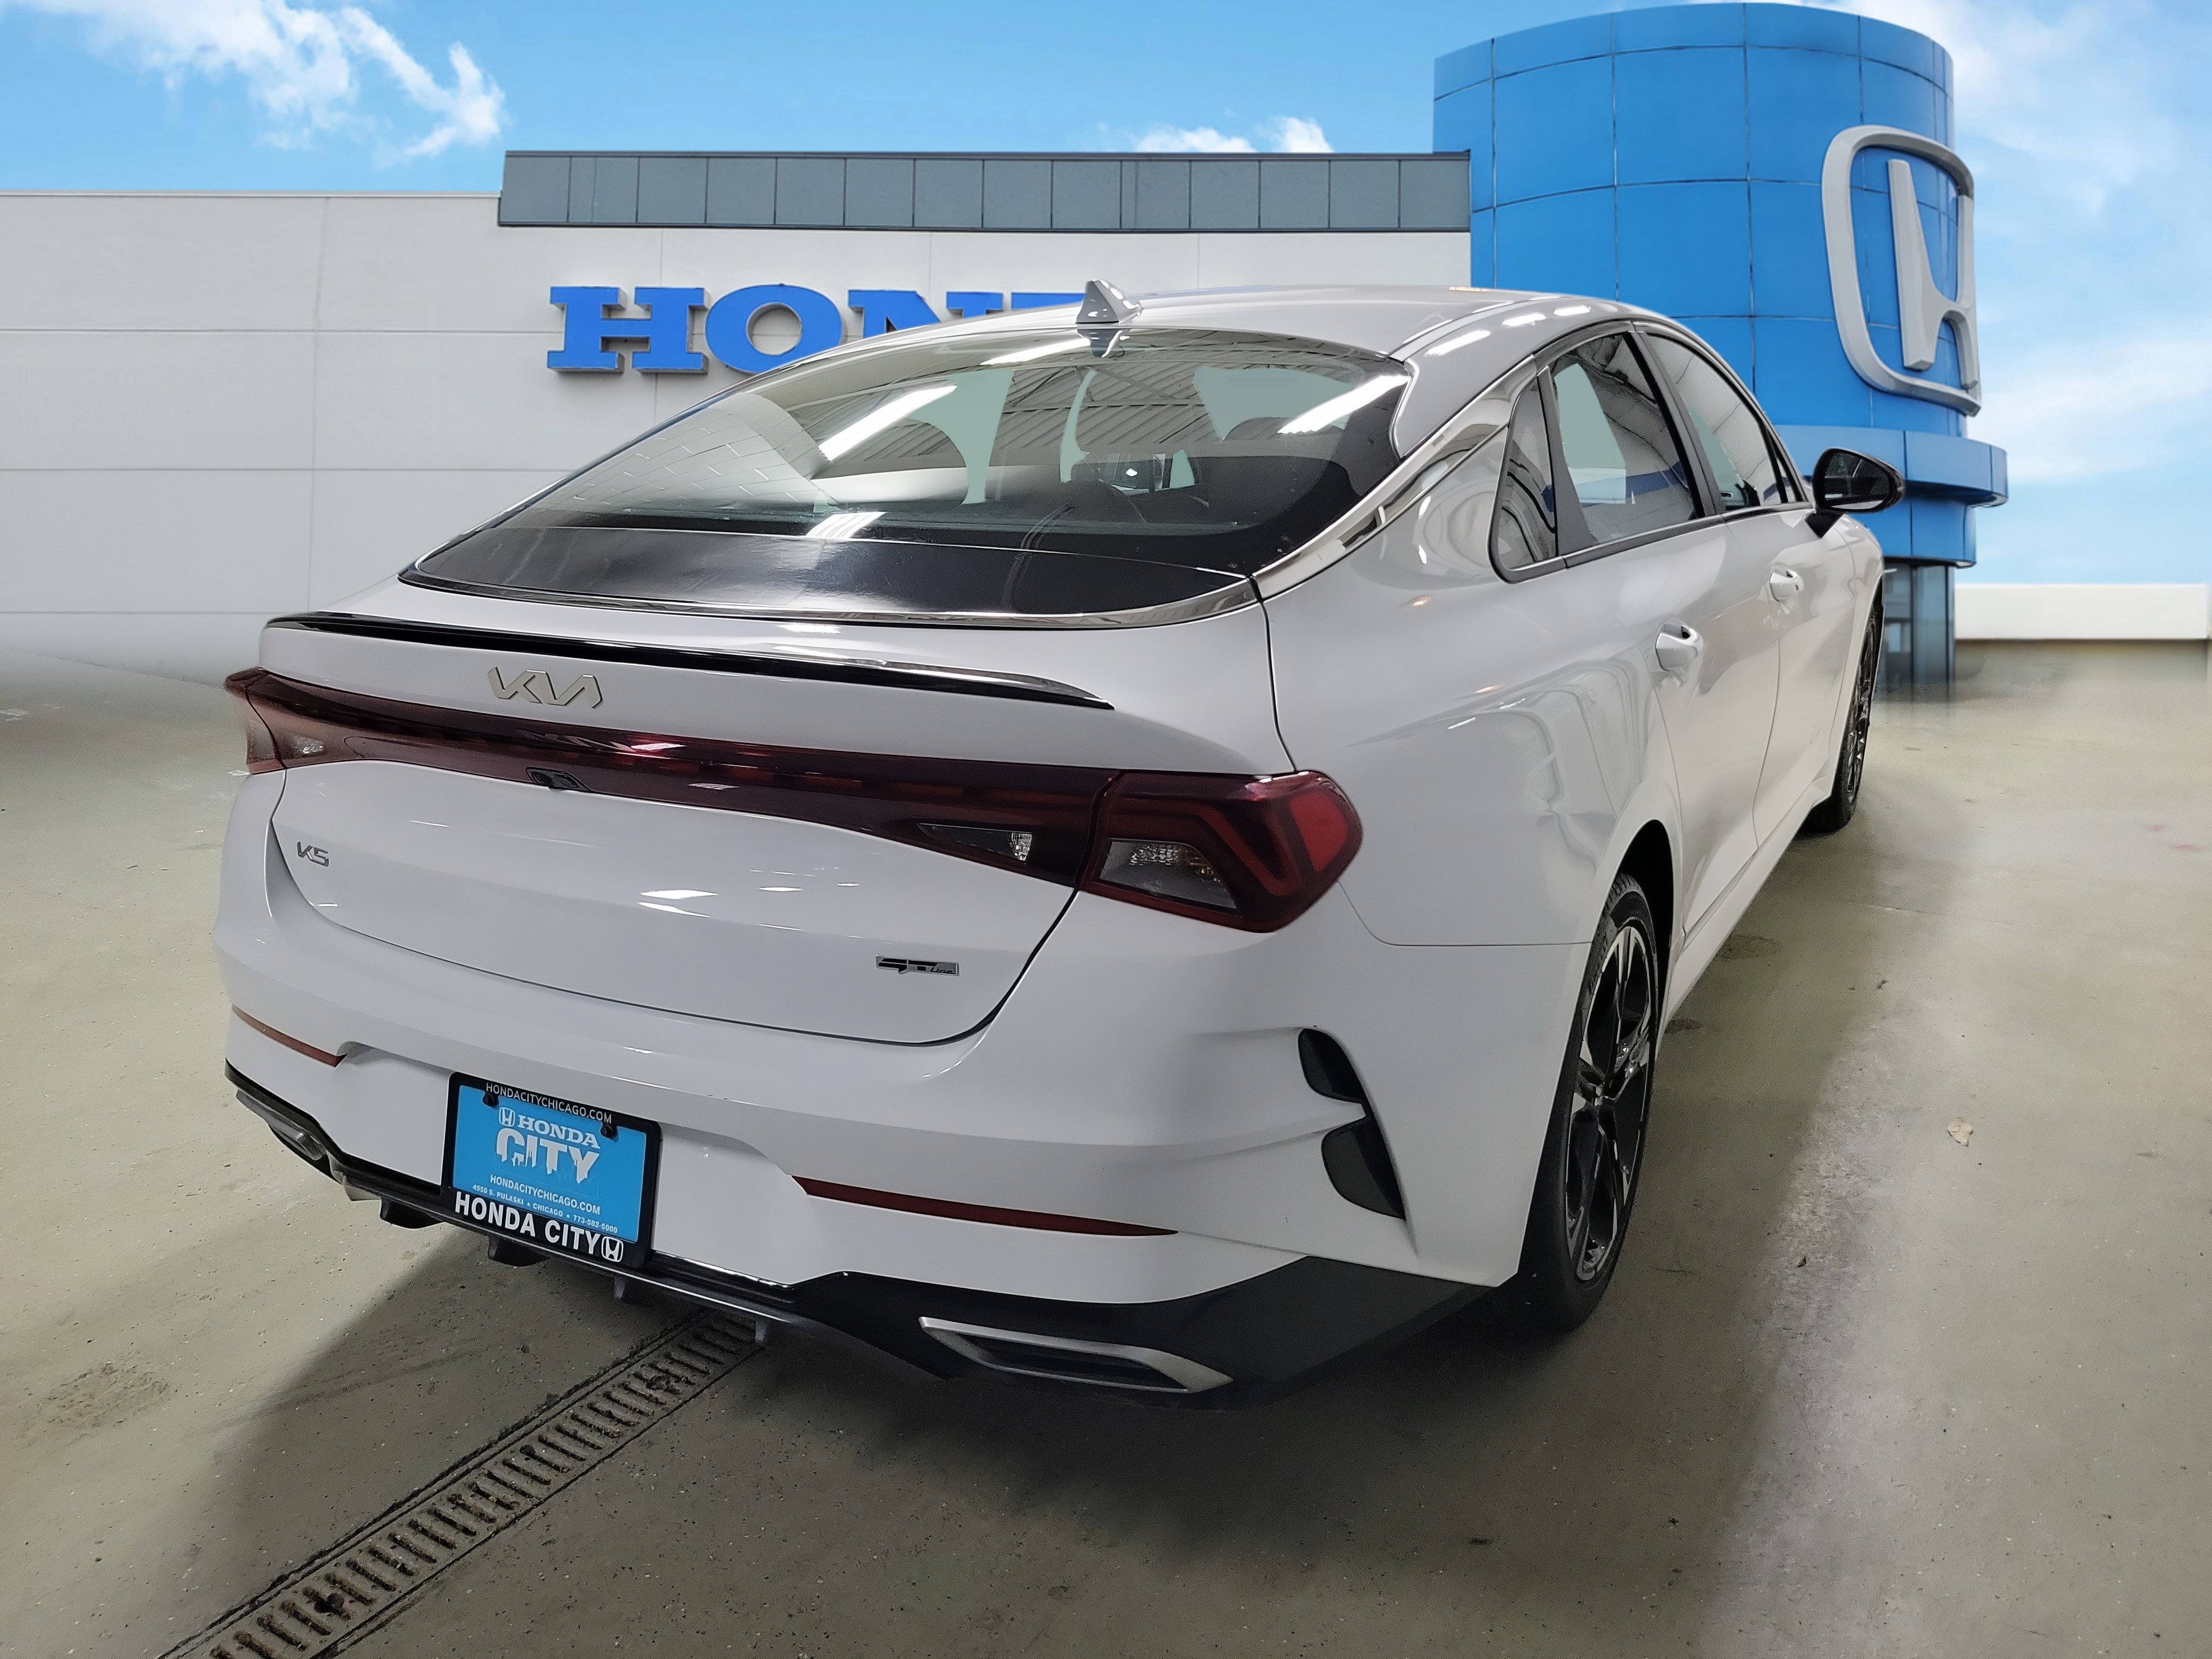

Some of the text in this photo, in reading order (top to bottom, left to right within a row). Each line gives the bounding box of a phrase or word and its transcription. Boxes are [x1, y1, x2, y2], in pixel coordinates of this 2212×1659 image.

[297, 841, 329, 867] K5
[485, 1082, 612, 1124] HONDACITYCHICAGO.COM
[517, 1114, 601, 1149] HONDA
[496, 1127, 600, 1184] CITY
[490, 1174, 601, 1215] HONDACITYCHICAGO.COM
[496, 1192, 524, 1206] PULASKI
[533, 1203, 563, 1218] CHICAGO
[455, 1191, 536, 1238] HONDA
[545, 1219, 601, 1255] CITY
